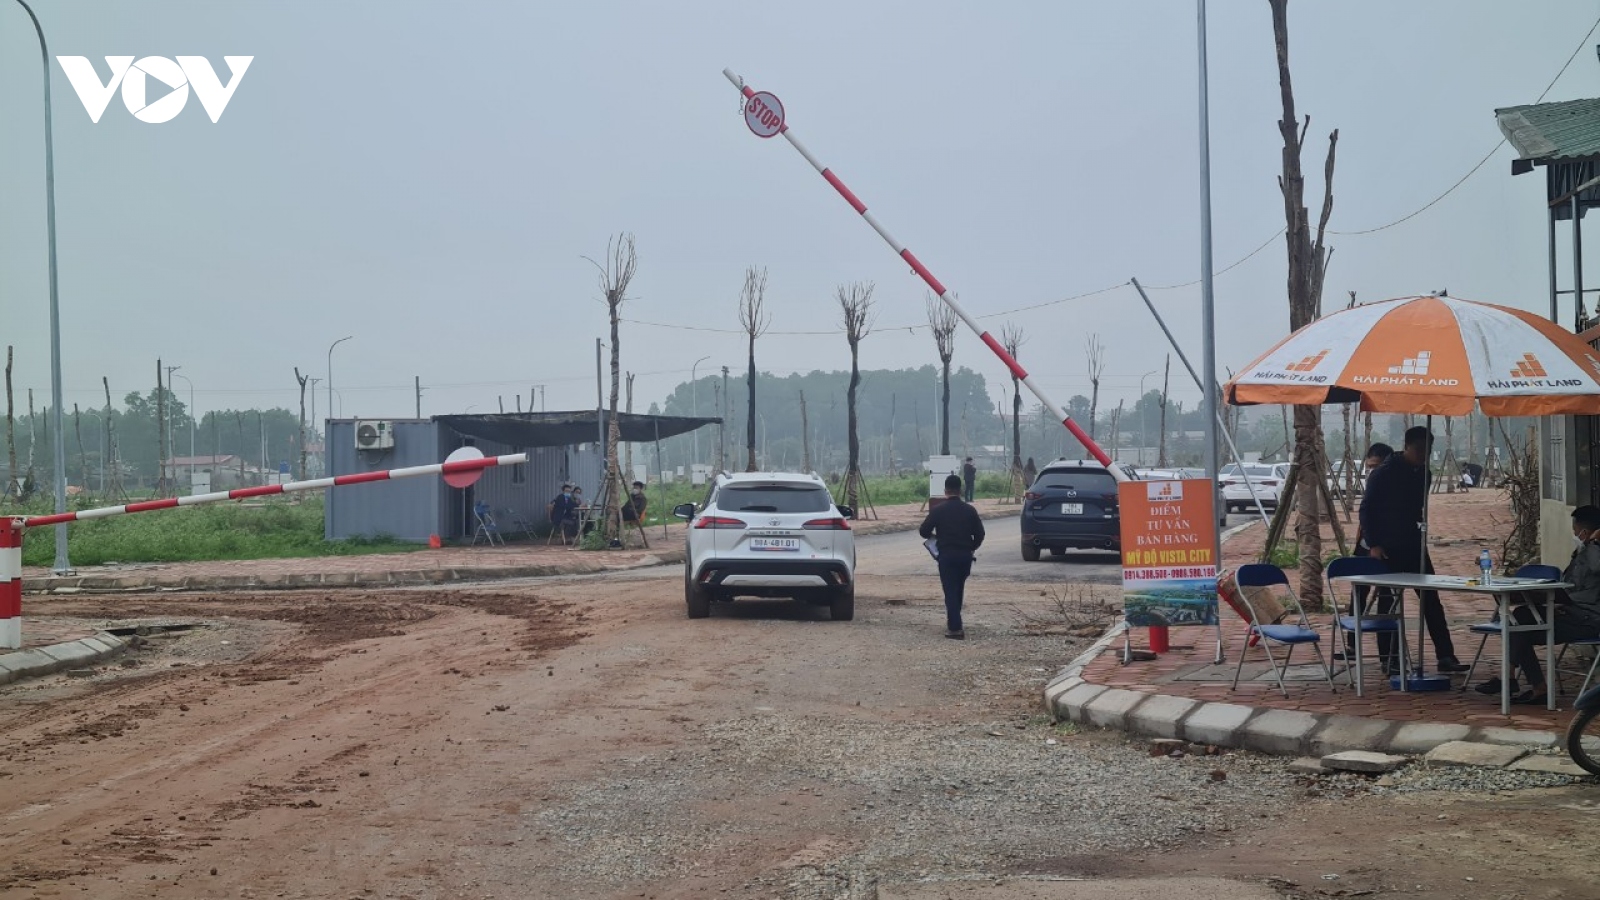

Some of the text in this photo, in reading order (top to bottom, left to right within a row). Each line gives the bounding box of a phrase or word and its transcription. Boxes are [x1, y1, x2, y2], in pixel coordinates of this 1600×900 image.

[748, 97, 781, 129] STOP
[1299, 375, 1328, 383] LAND
[1379, 374, 1416, 385] PHÁT
[1419, 378, 1459, 386] LAND
[1546, 379, 1582, 387] LAND
[1137, 531, 1198, 545] BÁN HÀNG
[1159, 549, 1187, 564] VISTA
[1189, 548, 1211, 563] CITY
